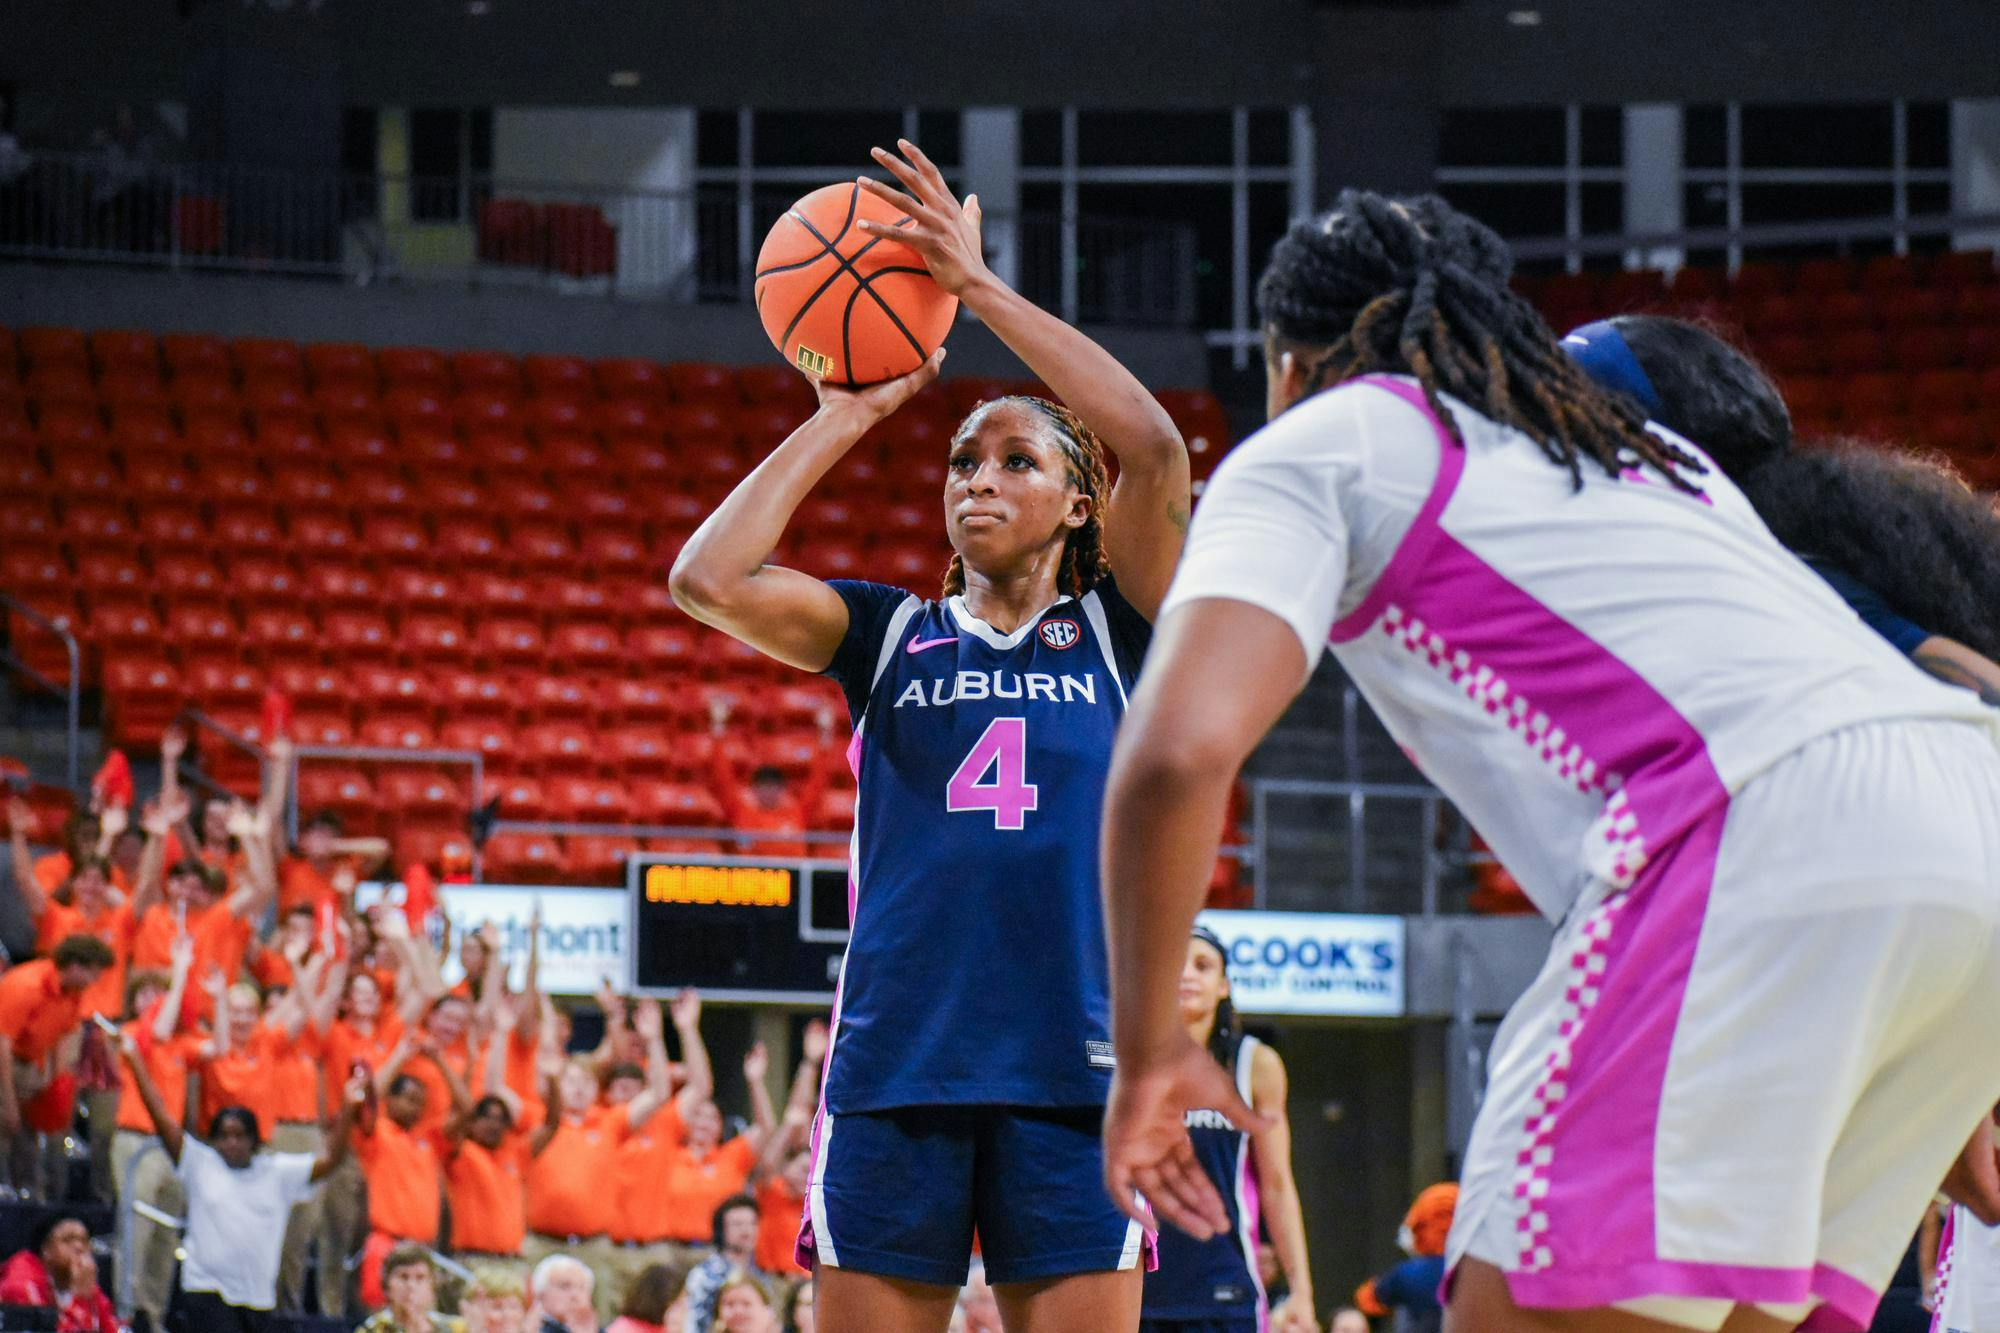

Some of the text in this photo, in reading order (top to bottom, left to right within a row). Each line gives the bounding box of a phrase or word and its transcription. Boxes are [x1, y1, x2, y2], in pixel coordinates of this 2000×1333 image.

[1044, 621, 1077, 647] SEC
[893, 669, 1097, 708] AUBURN
[946, 716, 1038, 831] 4
[1230, 936, 1394, 971] COOK'S
